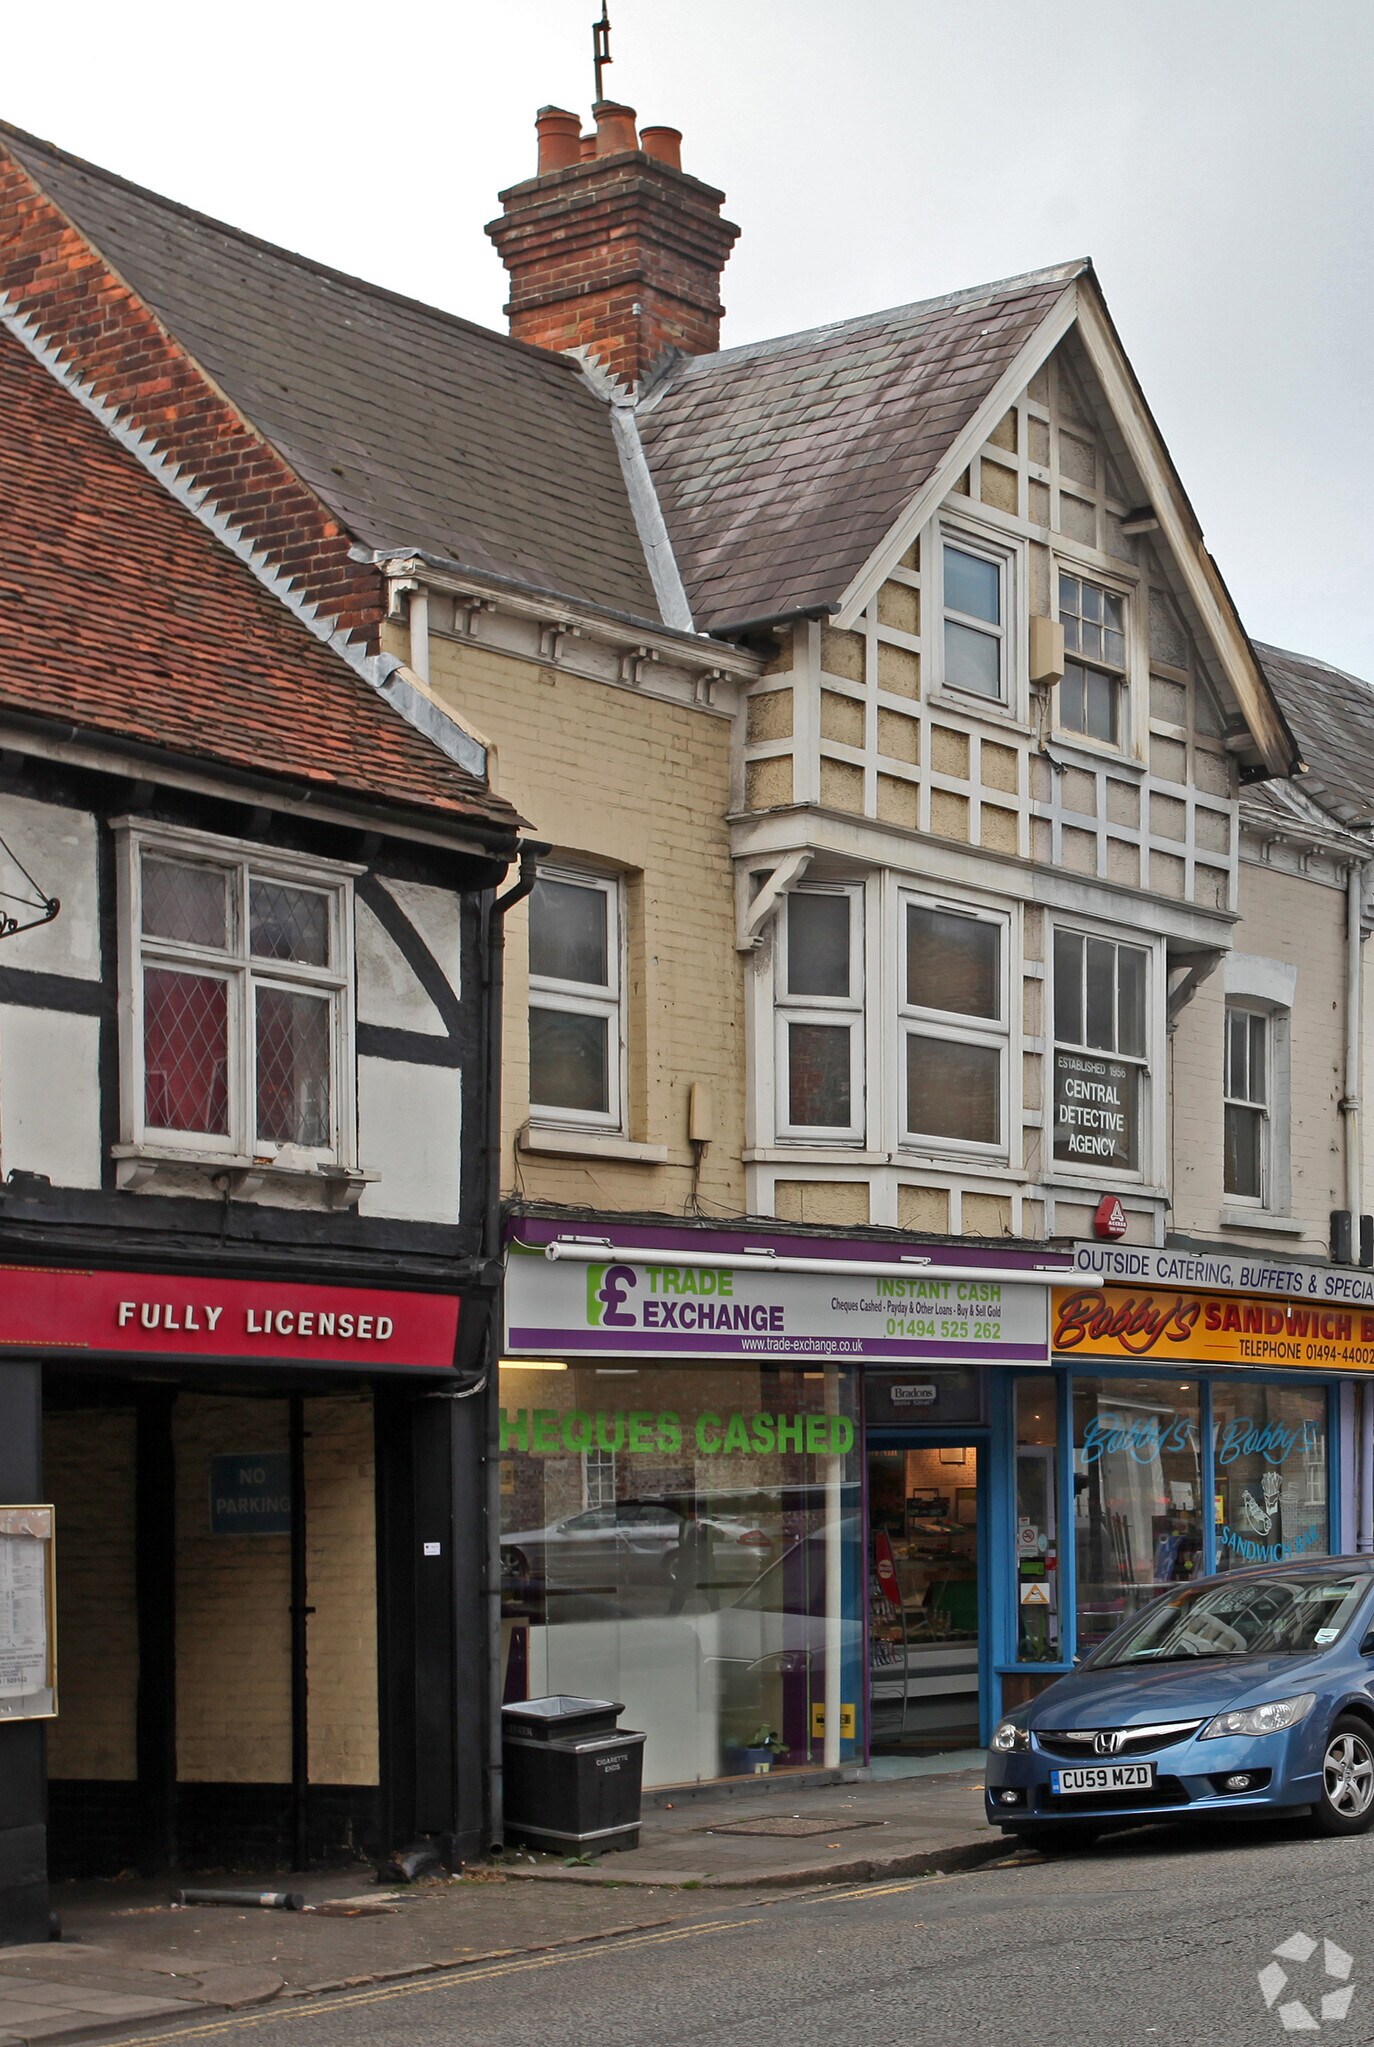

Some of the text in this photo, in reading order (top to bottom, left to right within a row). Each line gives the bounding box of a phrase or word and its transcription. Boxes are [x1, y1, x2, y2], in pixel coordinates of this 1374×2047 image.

[1058, 1056, 1126, 1078] ESTABLISHED 1956
[1065, 1078, 1120, 1105] CENTRAL
[1059, 1104, 1124, 1132] DETECTIVE
[1068, 1133, 1116, 1157] AGENCY
[645, 1267, 734, 1296] TRADE
[1077, 1249, 1374, 1300] OUTSIDE CATERING, BUFFETS & SPECIA
[876, 1278, 1001, 1302] INSTANT CASH
[643, 1301, 784, 1331] EXCHANGE
[831, 1297, 858, 1314] Cheques
[859, 1299, 882, 1312] Cashed
[887, 1300, 908, 1316] Payday
[909, 1301, 914, 1313] &
[915, 1302, 934, 1315] Other
[935, 1303, 953, 1316] Loans
[957, 1304, 968, 1319] Buy
[969, 1305, 975, 1317] &
[975, 1306, 986, 1317] Sell
[987, 1307, 1001, 1318] Gold
[118, 1301, 393, 1339] FULLY LICENSED
[886, 1318, 1001, 1339] 01494 525 262
[1205, 1302, 1352, 1341] SANDWICH
[741, 1336, 863, 1354] www.trade-exchange.co.uk
[1239, 1339, 1302, 1359] TELEPHONE
[895, 1387, 933, 1398] Bradons
[500, 1408, 854, 1456] HEQUES CASHED
[240, 1467, 266, 1485] NO
[216, 1496, 291, 1515] PARKING
[1221, 1525, 1292, 1563] SANDWICH
[596, 1754, 628, 1766] CIGARETTE
[605, 1763, 621, 1773] ENDS
[1062, 1766, 1148, 1789] CU59 MZD
